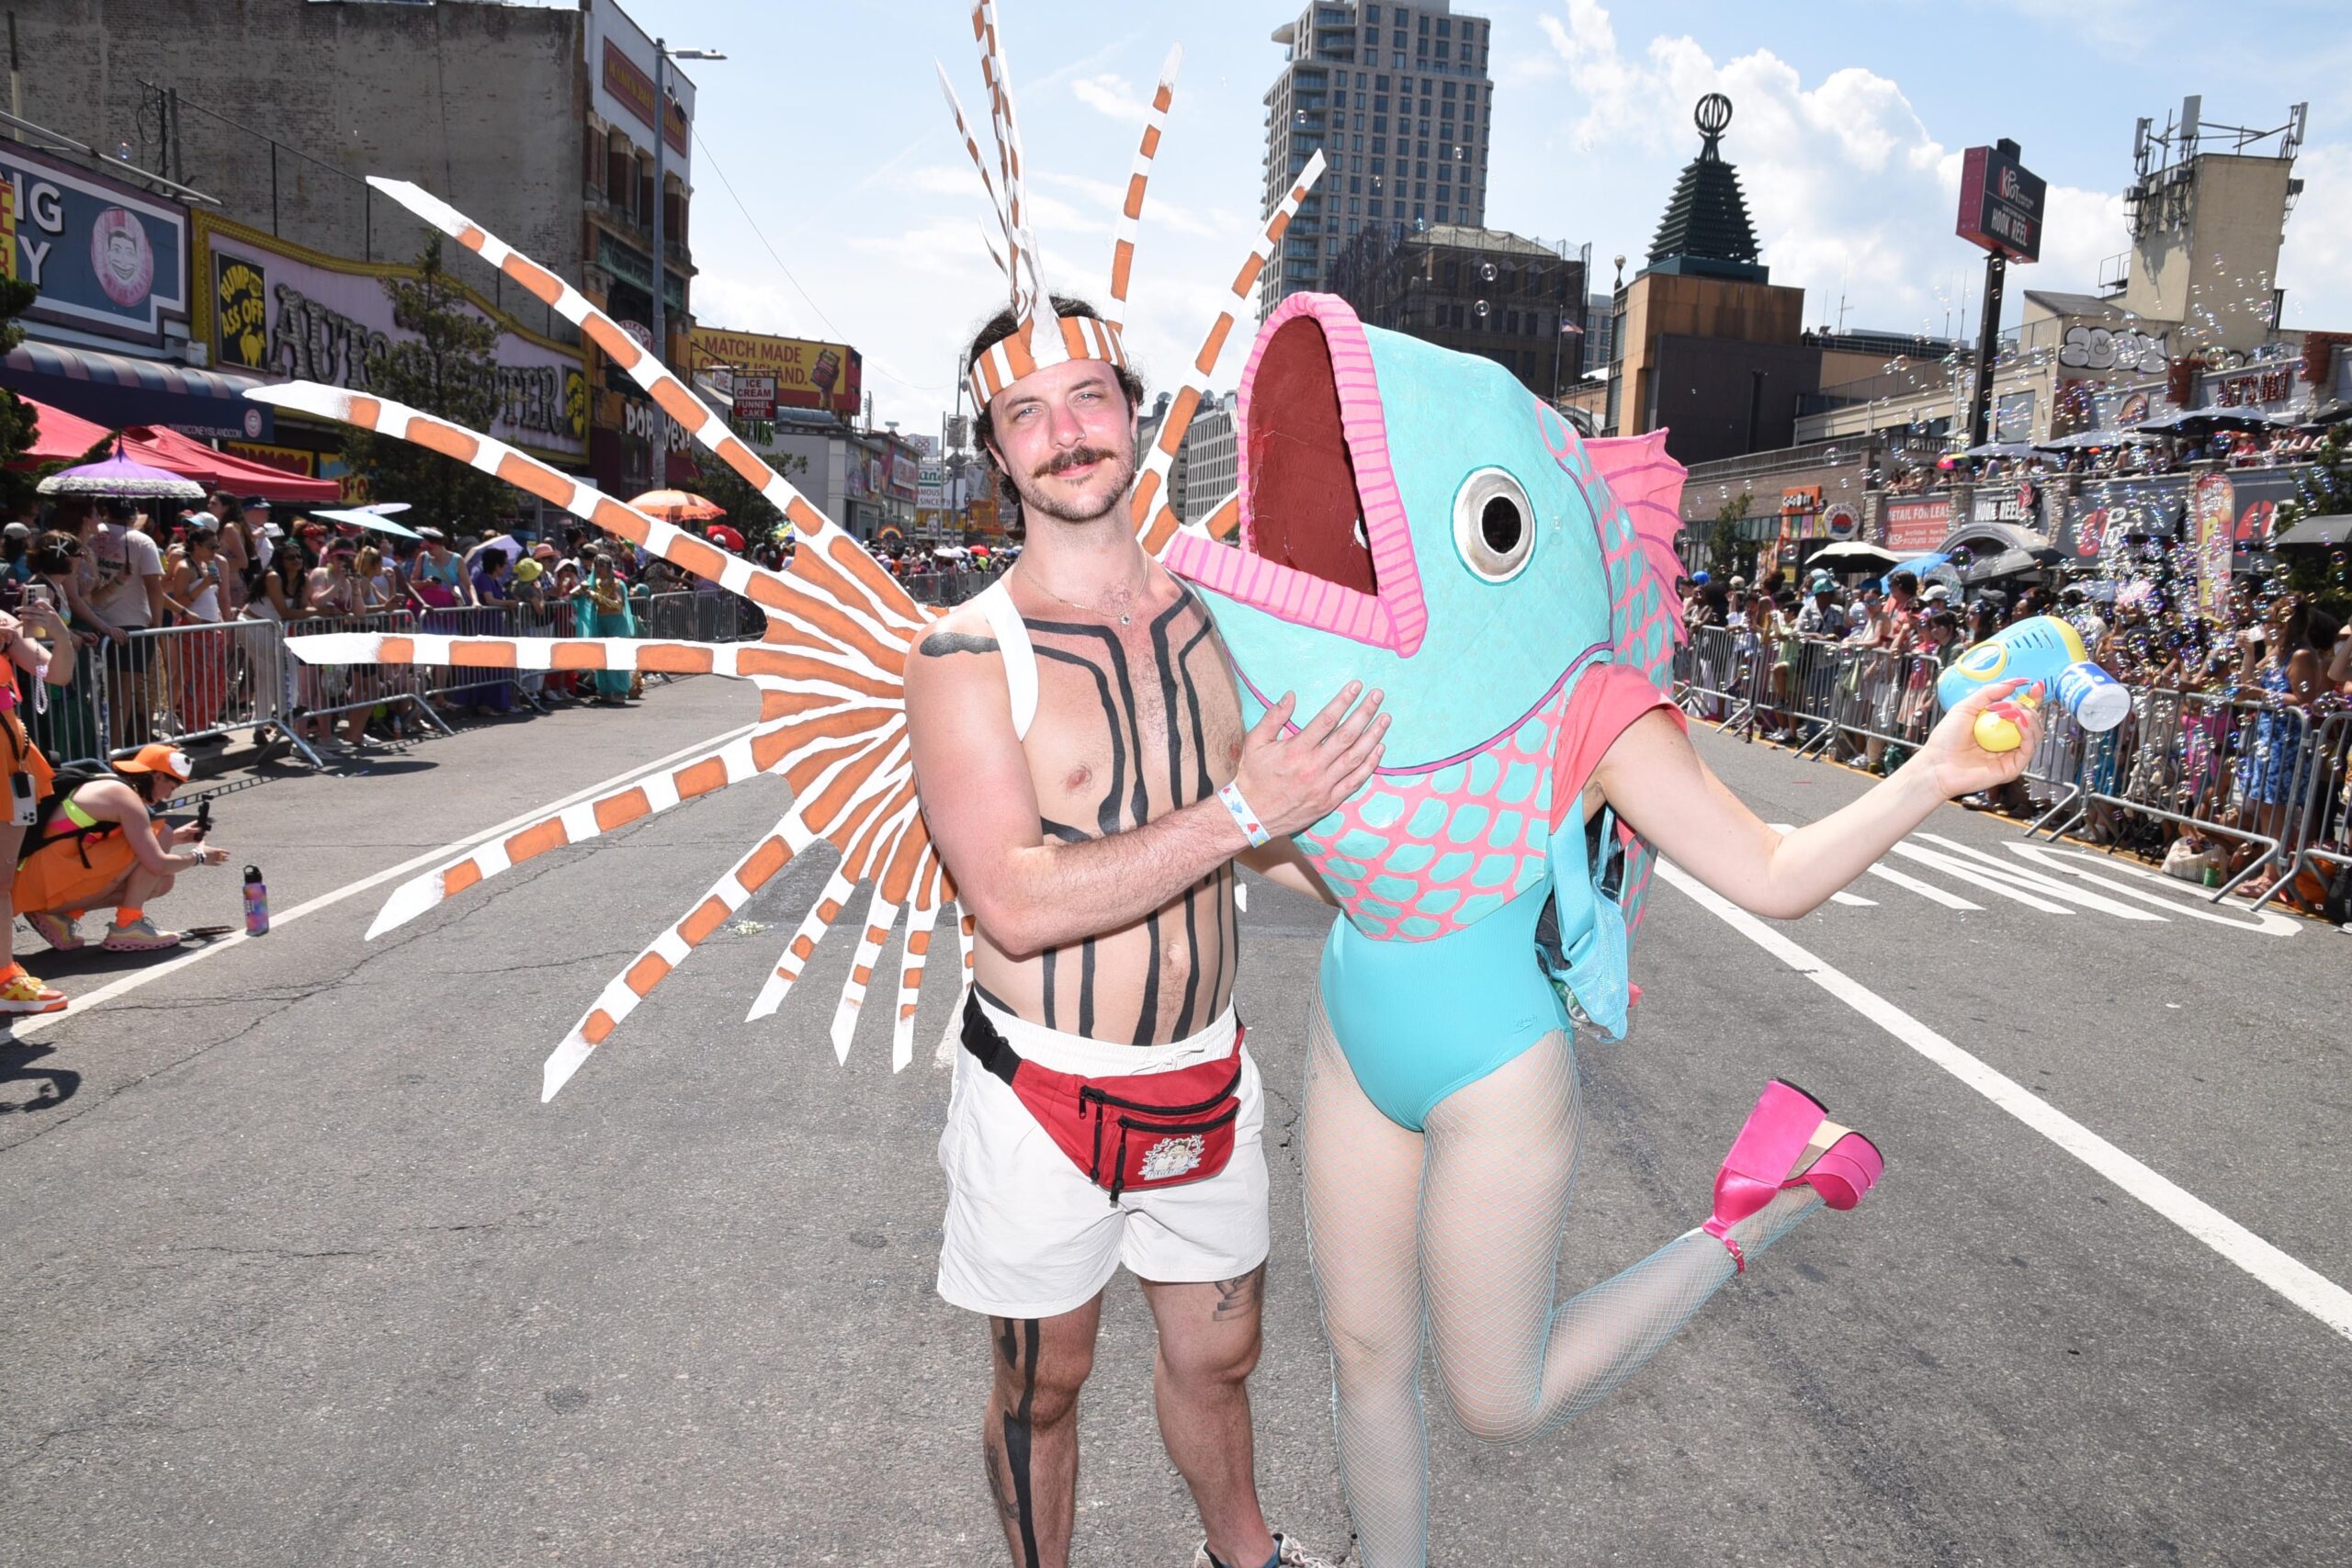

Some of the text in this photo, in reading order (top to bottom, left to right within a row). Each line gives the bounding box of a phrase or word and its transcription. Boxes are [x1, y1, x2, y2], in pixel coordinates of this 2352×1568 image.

[1991, 208, 2010, 237] HOOK
[2010, 220, 2028, 246] REEL
[220, 265, 250, 303] BUMP
[220, 298, 265, 338] ASS OFF
[705, 335, 756, 359] MATCH
[761, 340, 802, 364] MADE
[736, 388, 772, 398] CREAM
[745, 379, 763, 389] ICE
[736, 400, 772, 410] FUNNEL
[741, 409, 766, 418] CAKE
